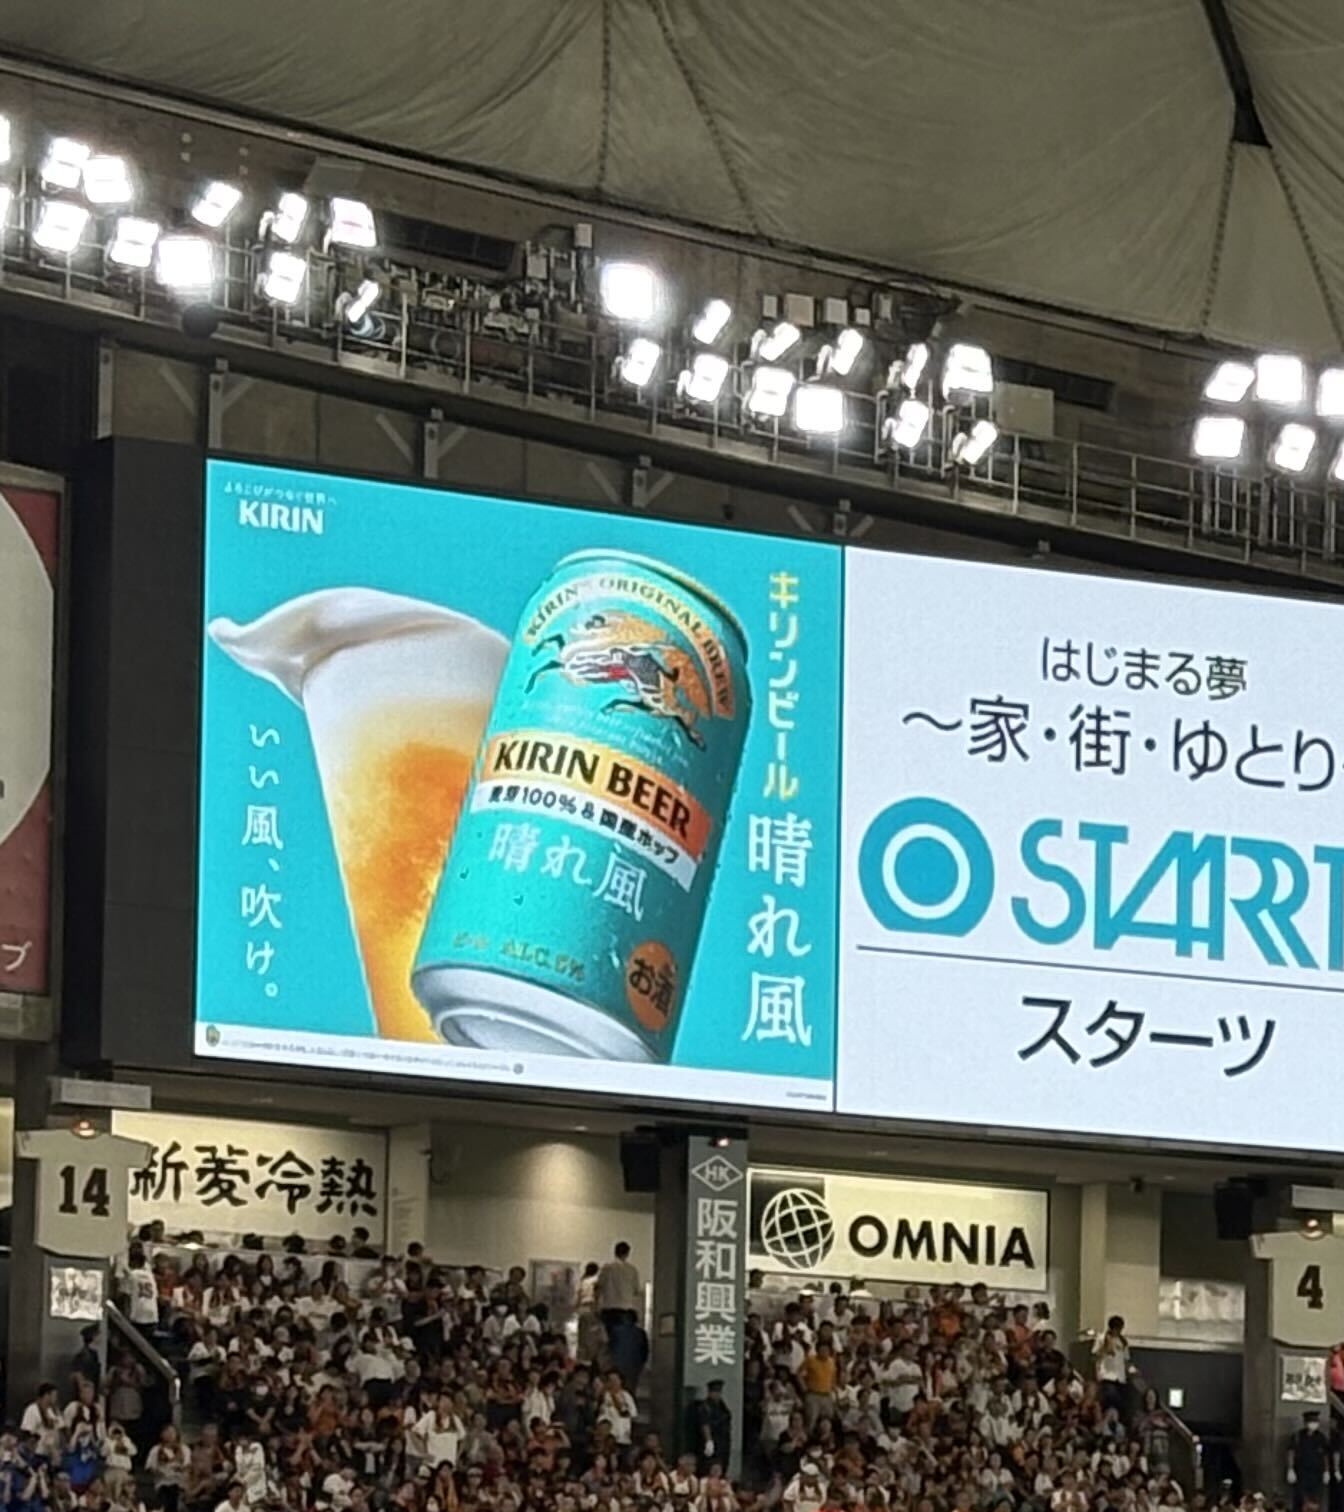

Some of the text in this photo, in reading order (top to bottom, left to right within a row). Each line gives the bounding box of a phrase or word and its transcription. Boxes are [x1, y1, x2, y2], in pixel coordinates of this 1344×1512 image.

[238, 499, 325, 535] KIRIN
[524, 585, 579, 638] KIRIN
[599, 575, 706, 640] ORIGINAL
[763, 571, 800, 801] キリンビール
[1041, 637, 1249, 700] はじまる夢
[493, 740, 692, 840] KIRIN BEER
[240, 722, 284, 1000] いい風、吹け。
[487, 821, 649, 922] 晴れ風
[741, 812, 814, 1048] 晴れ風
[628, 956, 678, 1017] お酒
[1017, 995, 1277, 1078] スターツ
[58, 1165, 110, 1217] 14
[704, 1163, 731, 1182] HK
[848, 1214, 1035, 1270] OMNIA
[694, 1198, 738, 1368] 阪和興業
[1297, 1265, 1324, 1309] 4
